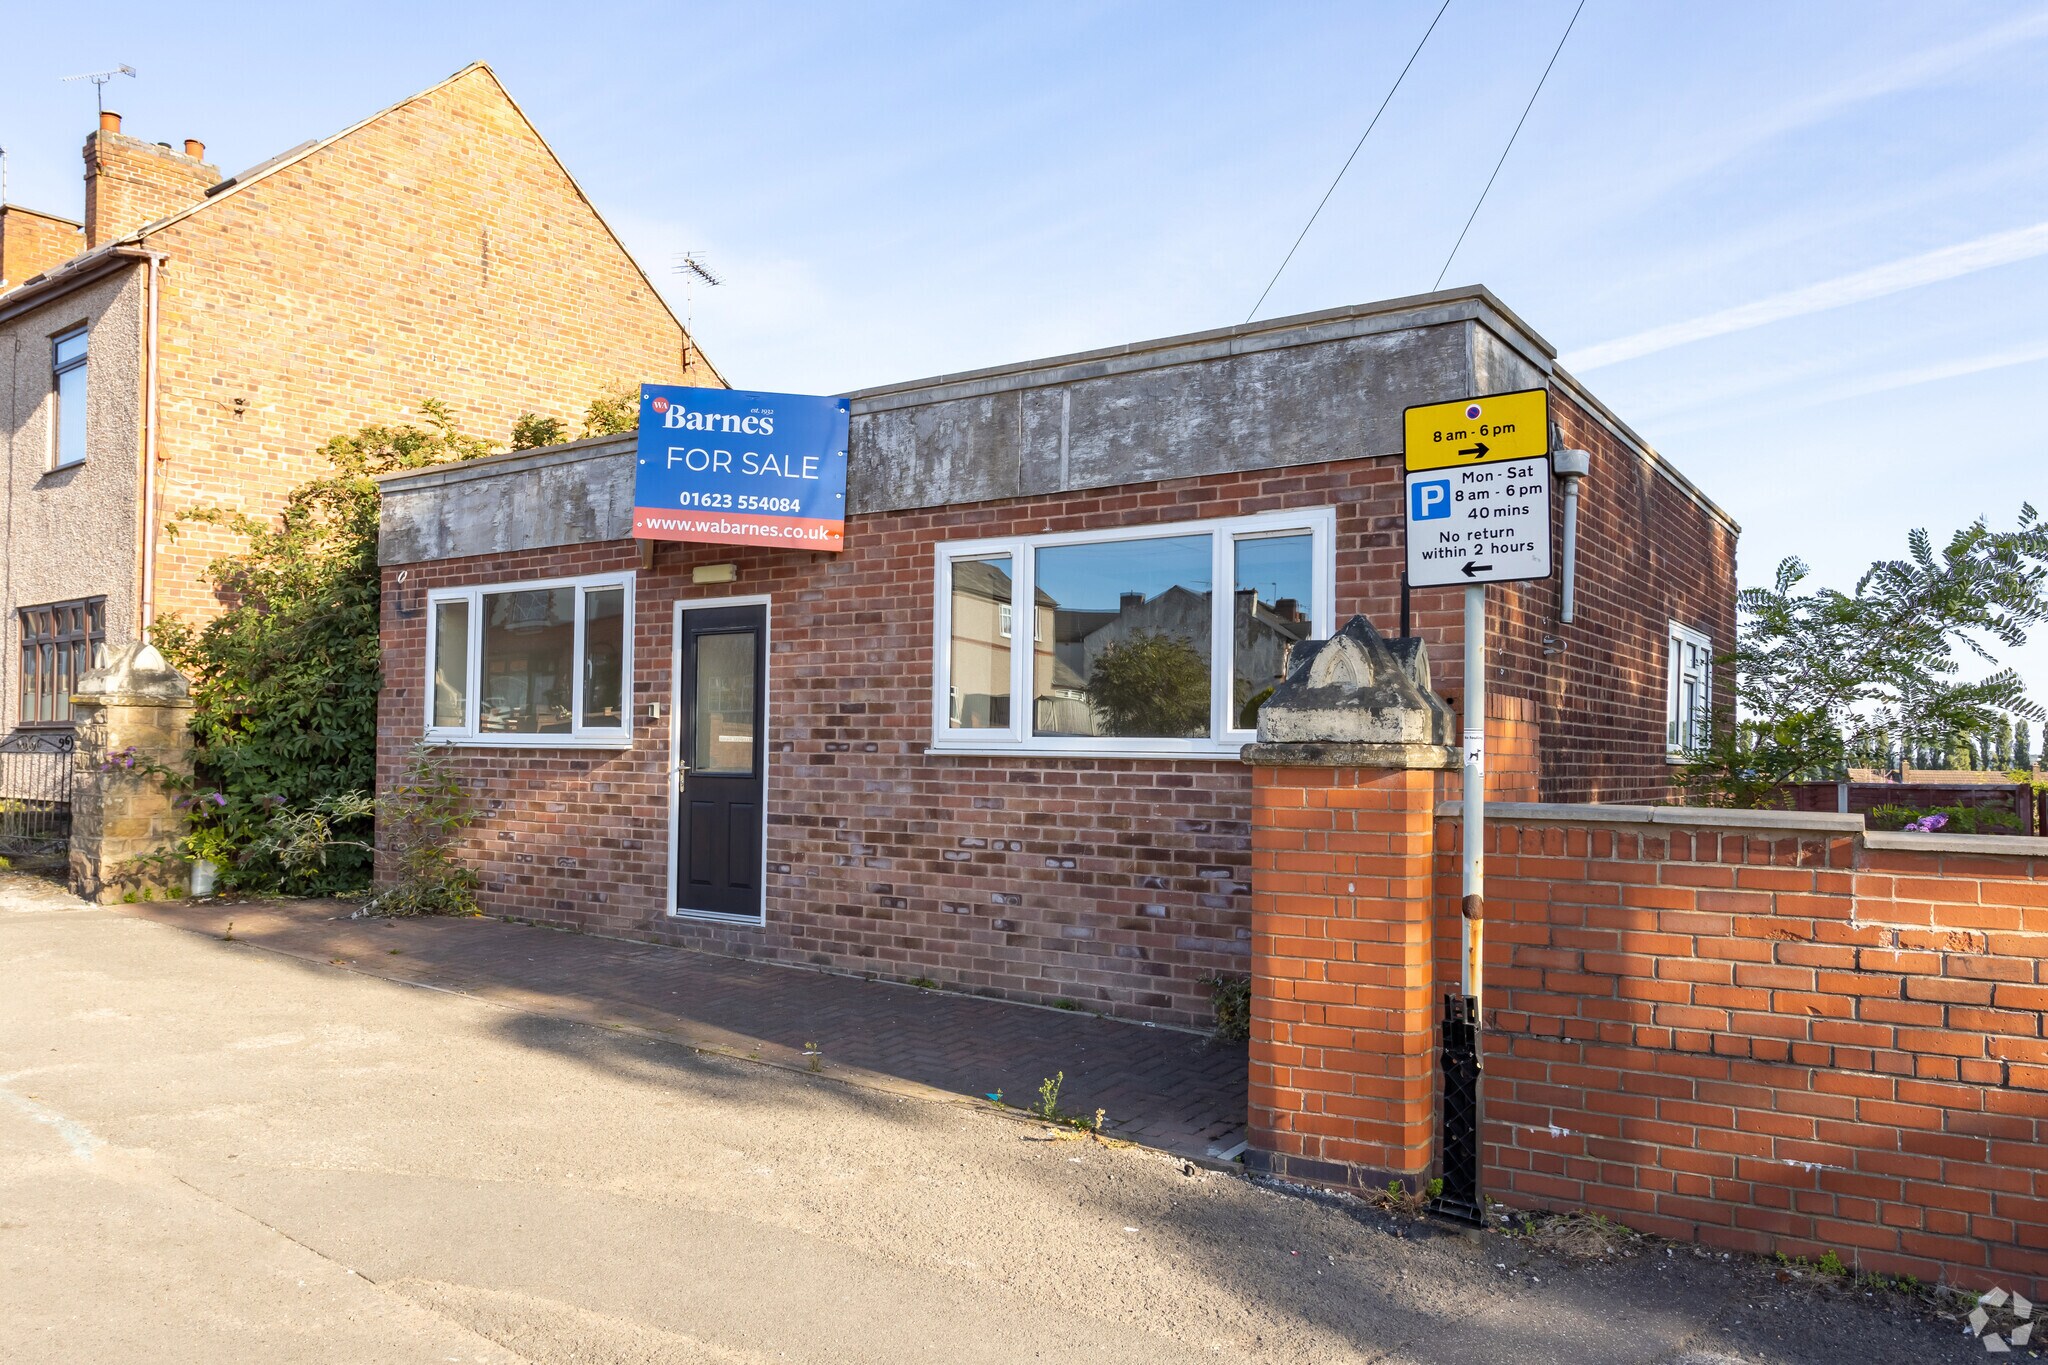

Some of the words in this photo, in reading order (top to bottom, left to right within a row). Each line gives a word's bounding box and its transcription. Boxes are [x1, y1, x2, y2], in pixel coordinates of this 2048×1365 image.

[654, 401, 667, 409] WA
[662, 404, 774, 435] Barnes
[1433, 431, 1442, 442] 8
[1446, 429, 1467, 441] am
[1480, 425, 1488, 436] 6
[1493, 423, 1515, 437] pm
[666, 447, 731, 473] FOR
[742, 452, 819, 479] SALE
[1462, 470, 1493, 484] Mon
[1507, 466, 1533, 479] Sat
[1421, 485, 1444, 516] P
[1455, 491, 1464, 501] 8
[1468, 489, 1489, 500] am
[1506, 485, 1514, 496] 6
[1519, 483, 1542, 497] pm
[680, 492, 732, 507] 01623
[738, 495, 800, 512] 554084
[1468, 508, 1489, 519] 40
[1494, 505, 1529, 516] mins
[646, 517, 829, 540] www.wabarnes.co.uk
[1439, 531, 1460, 543] No
[1467, 527, 1514, 541] return
[1422, 546, 1466, 559] within
[1474, 544, 1483, 555] 2
[1491, 541, 1534, 554] hours
